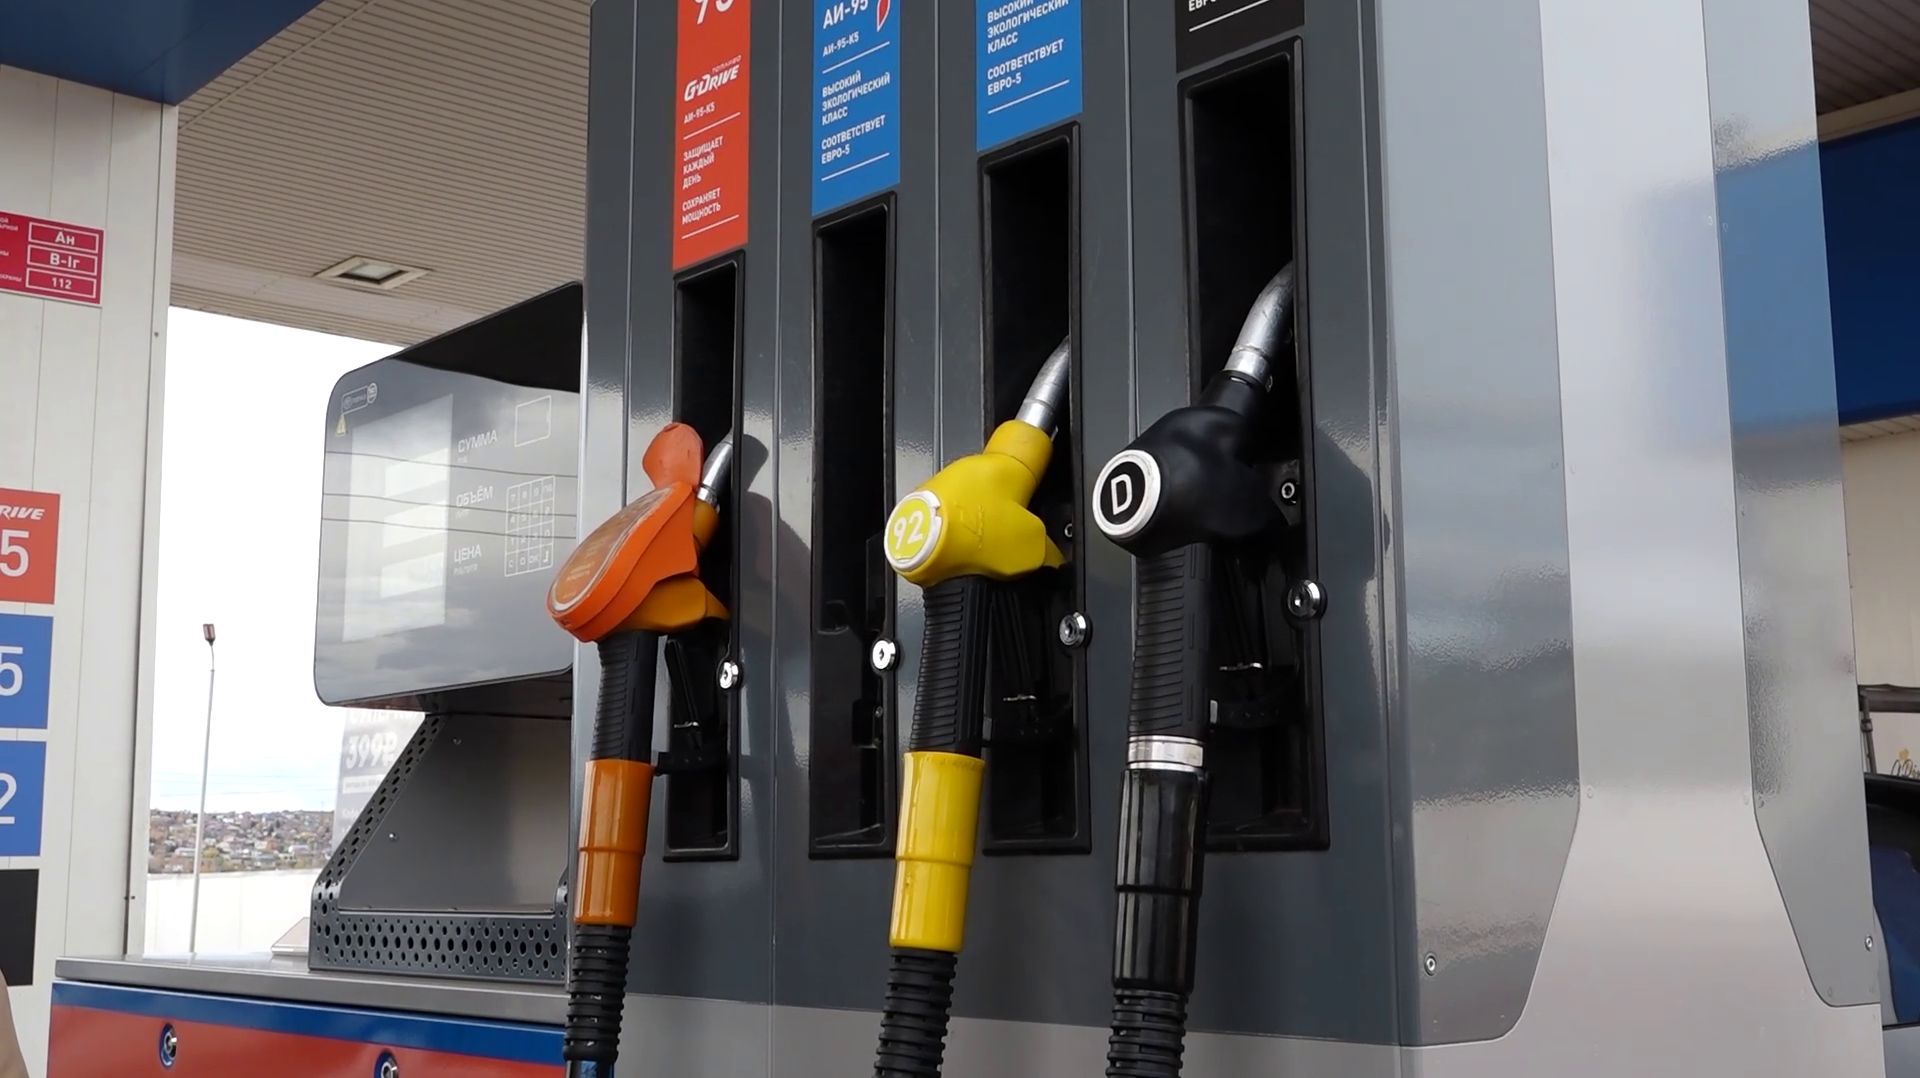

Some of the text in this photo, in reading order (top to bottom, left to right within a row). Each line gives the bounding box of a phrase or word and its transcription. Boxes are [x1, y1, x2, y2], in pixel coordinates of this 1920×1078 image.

[987, 32, 1018, 54] КЛАСС
[987, 38, 1064, 80] СООТВЕТСТВУЕТ
[822, 70, 861, 97] ВЫСОКИЙ
[822, 72, 890, 111] ЭКОЛОГИЧЕСКИЙ
[987, 72, 1022, 95] ЕВРО-5
[822, 106, 848, 125] КЛАСС
[821, 114, 886, 150] СООТВЕТСТВУЕТ
[683, 136, 724, 161] ЗАЩИЩАЕТ
[821, 144, 850, 164] ЕВРО-5
[683, 152, 715, 174] КАЖДЫЙ
[683, 174, 702, 190] ДЕНЬ
[682, 187, 721, 211] СОХРАНЯЕТ
[682, 202, 721, 225] МОЩНОСТЬ
[55, 231, 75, 246] Ан
[52, 277, 72, 290] 112
[458, 430, 498, 453] СУММА
[456, 485, 494, 507] ОБЪЁМ
[1111, 473, 1133, 516] D
[894, 510, 925, 551] 92
[454, 544, 482, 565] ЦЕНА
